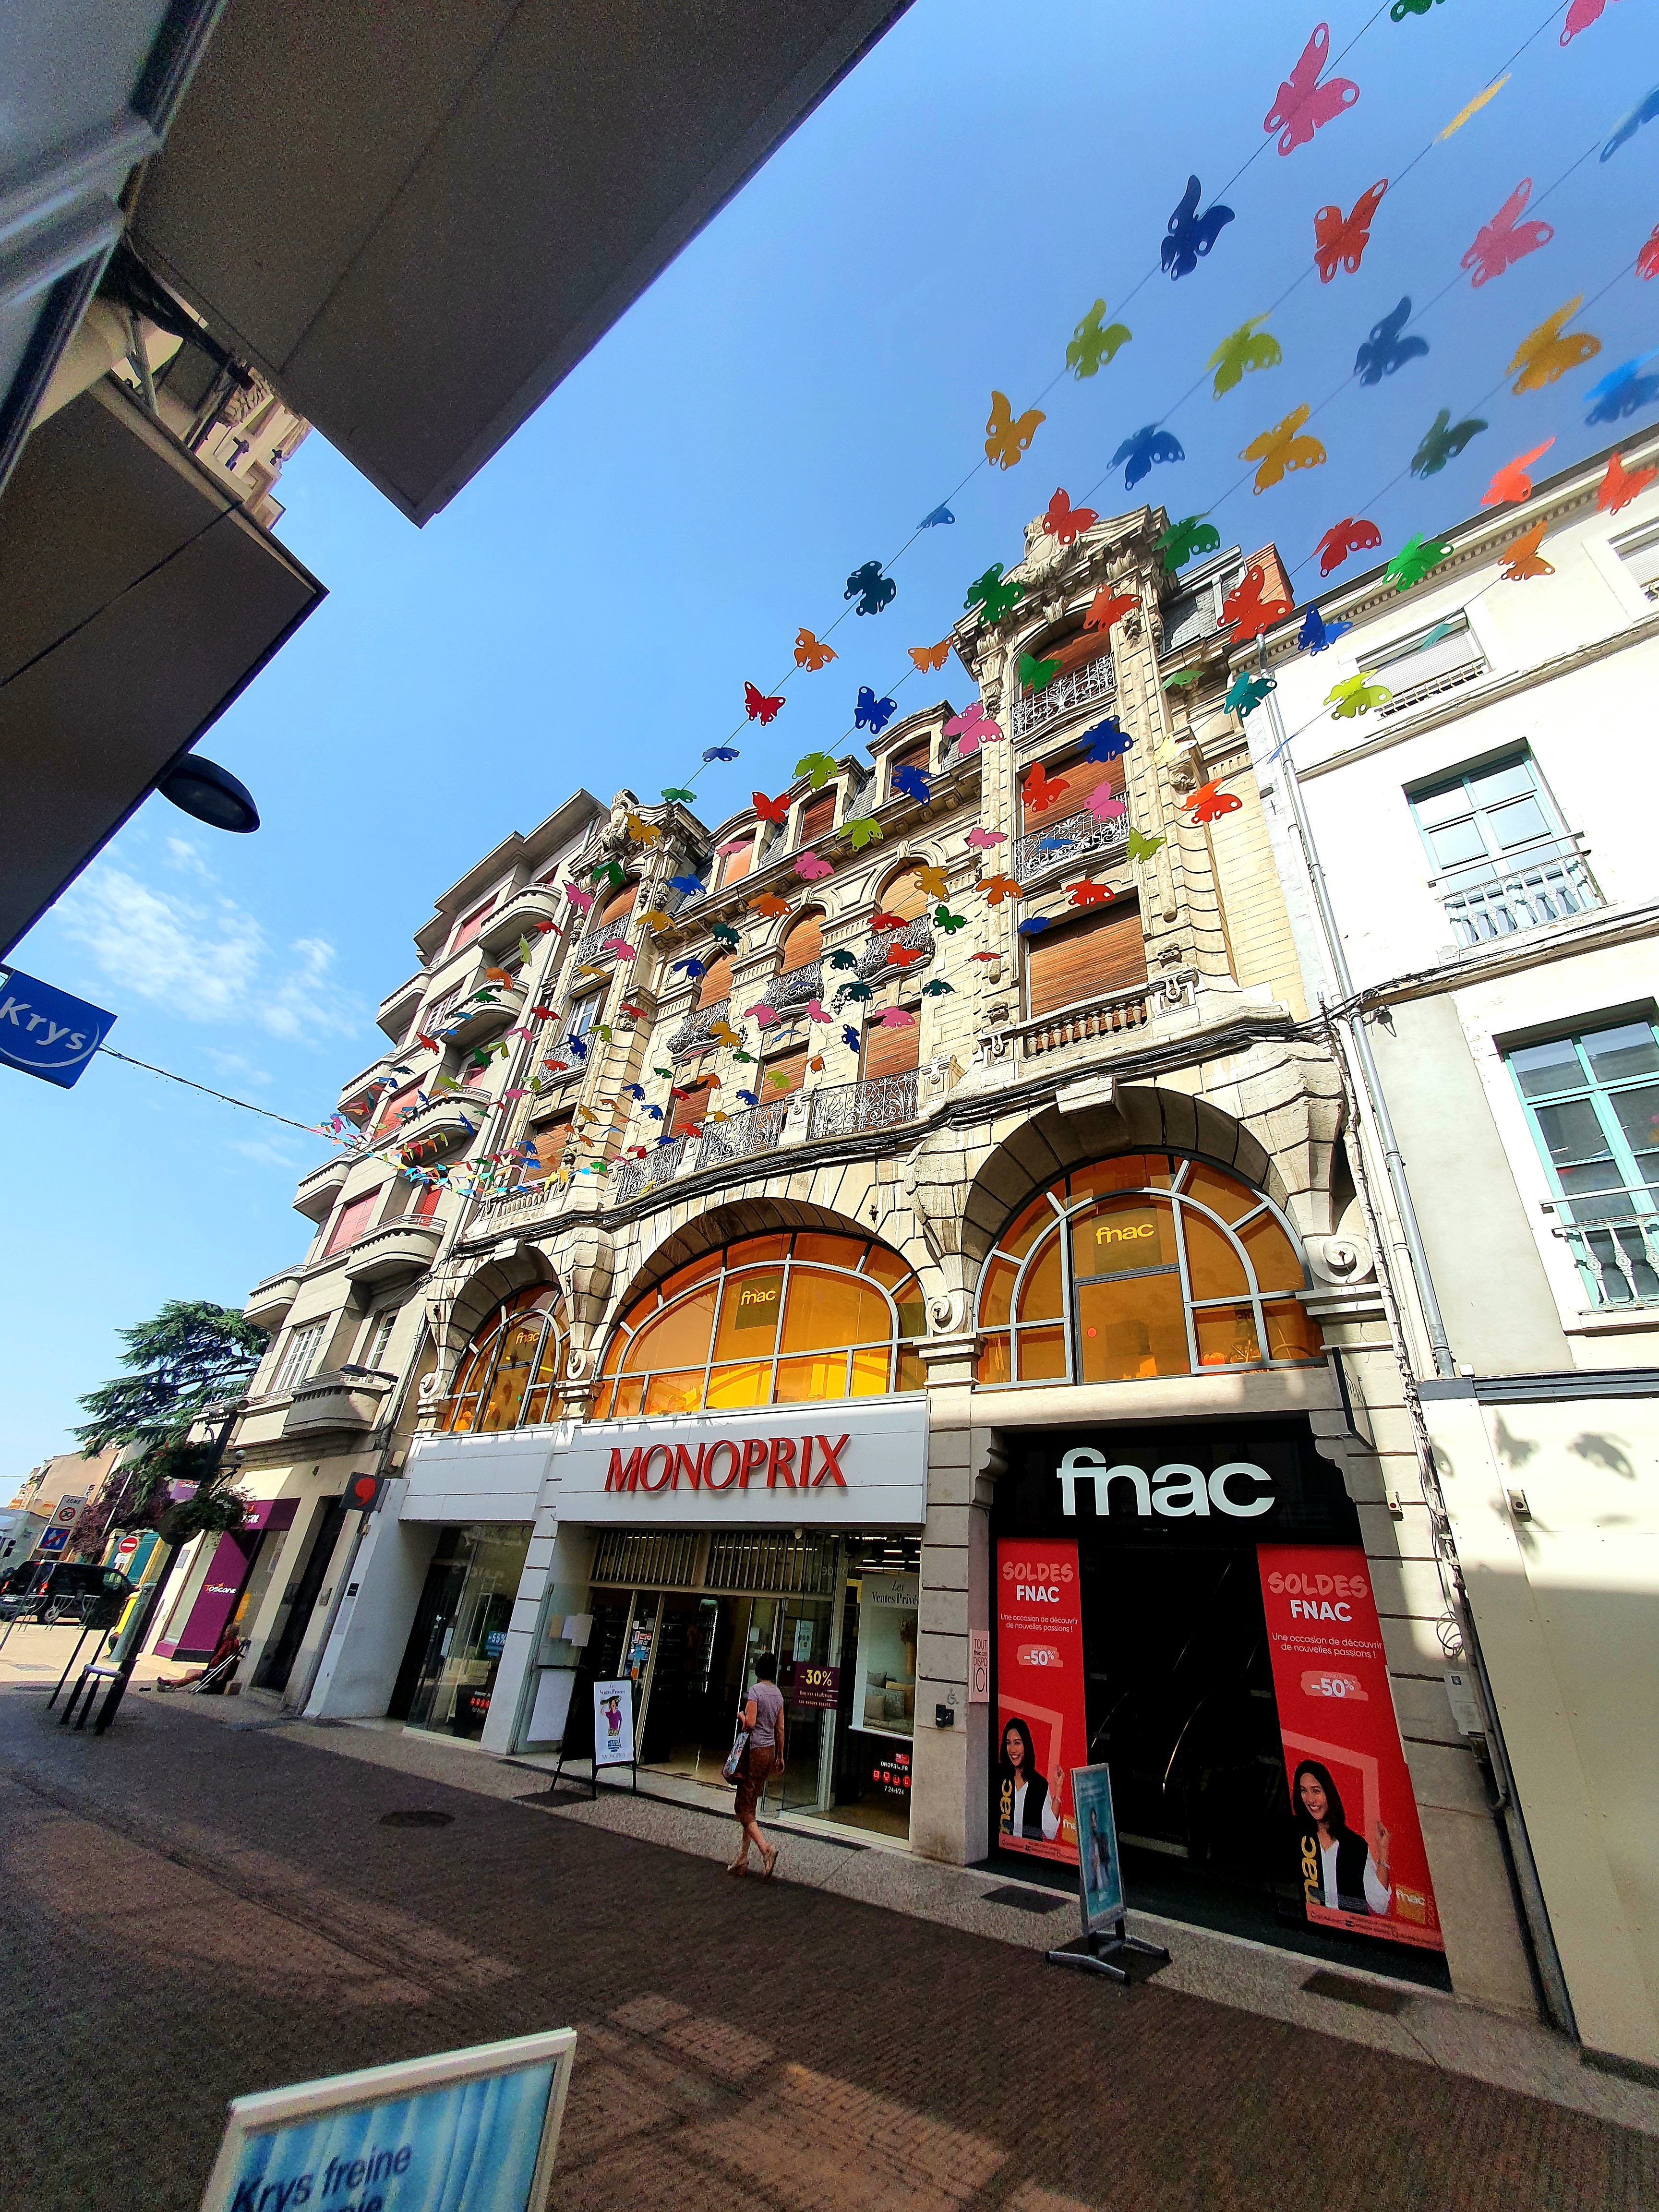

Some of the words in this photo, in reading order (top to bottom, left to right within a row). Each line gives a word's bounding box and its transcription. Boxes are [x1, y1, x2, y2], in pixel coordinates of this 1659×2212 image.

[0, 997, 86, 1049] Krys
[1096, 1224, 1154, 1245] fnac
[741, 1290, 776, 1305] fnac
[515, 1332, 540, 1344] fnac
[604, 1434, 851, 1491] MONOPRIX
[1057, 1447, 1275, 1517] fnac
[1002, 1561, 1073, 1583] SOLDES
[204, 1584, 237, 1593] Toscane
[1016, 1585, 1060, 1603] FNAC
[1268, 1572, 1368, 1599] SOLDES
[872, 1591, 895, 1603] Ventes
[896, 1592, 918, 1605] Privé
[1013, 1614, 1039, 1623] occasion
[1049, 1616, 1078, 1625] découvrir
[1290, 1599, 1353, 1622] FNAC
[1015, 1623, 1042, 1631] nouvelles
[1043, 1624, 1070, 1633] passions
[974, 1638, 987, 1649] TOUT
[1272, 1633, 1288, 1641] Une
[1290, 1635, 1327, 1645] occasion
[1328, 1637, 1340, 1646] de
[1342, 1638, 1382, 1649] découvrir
[1294, 1644, 1332, 1655] nouvelles
[1334, 1649, 1371, 1659] passions
[973, 1667, 987, 1693] ICI
[322, 2143, 413, 2199] freine
